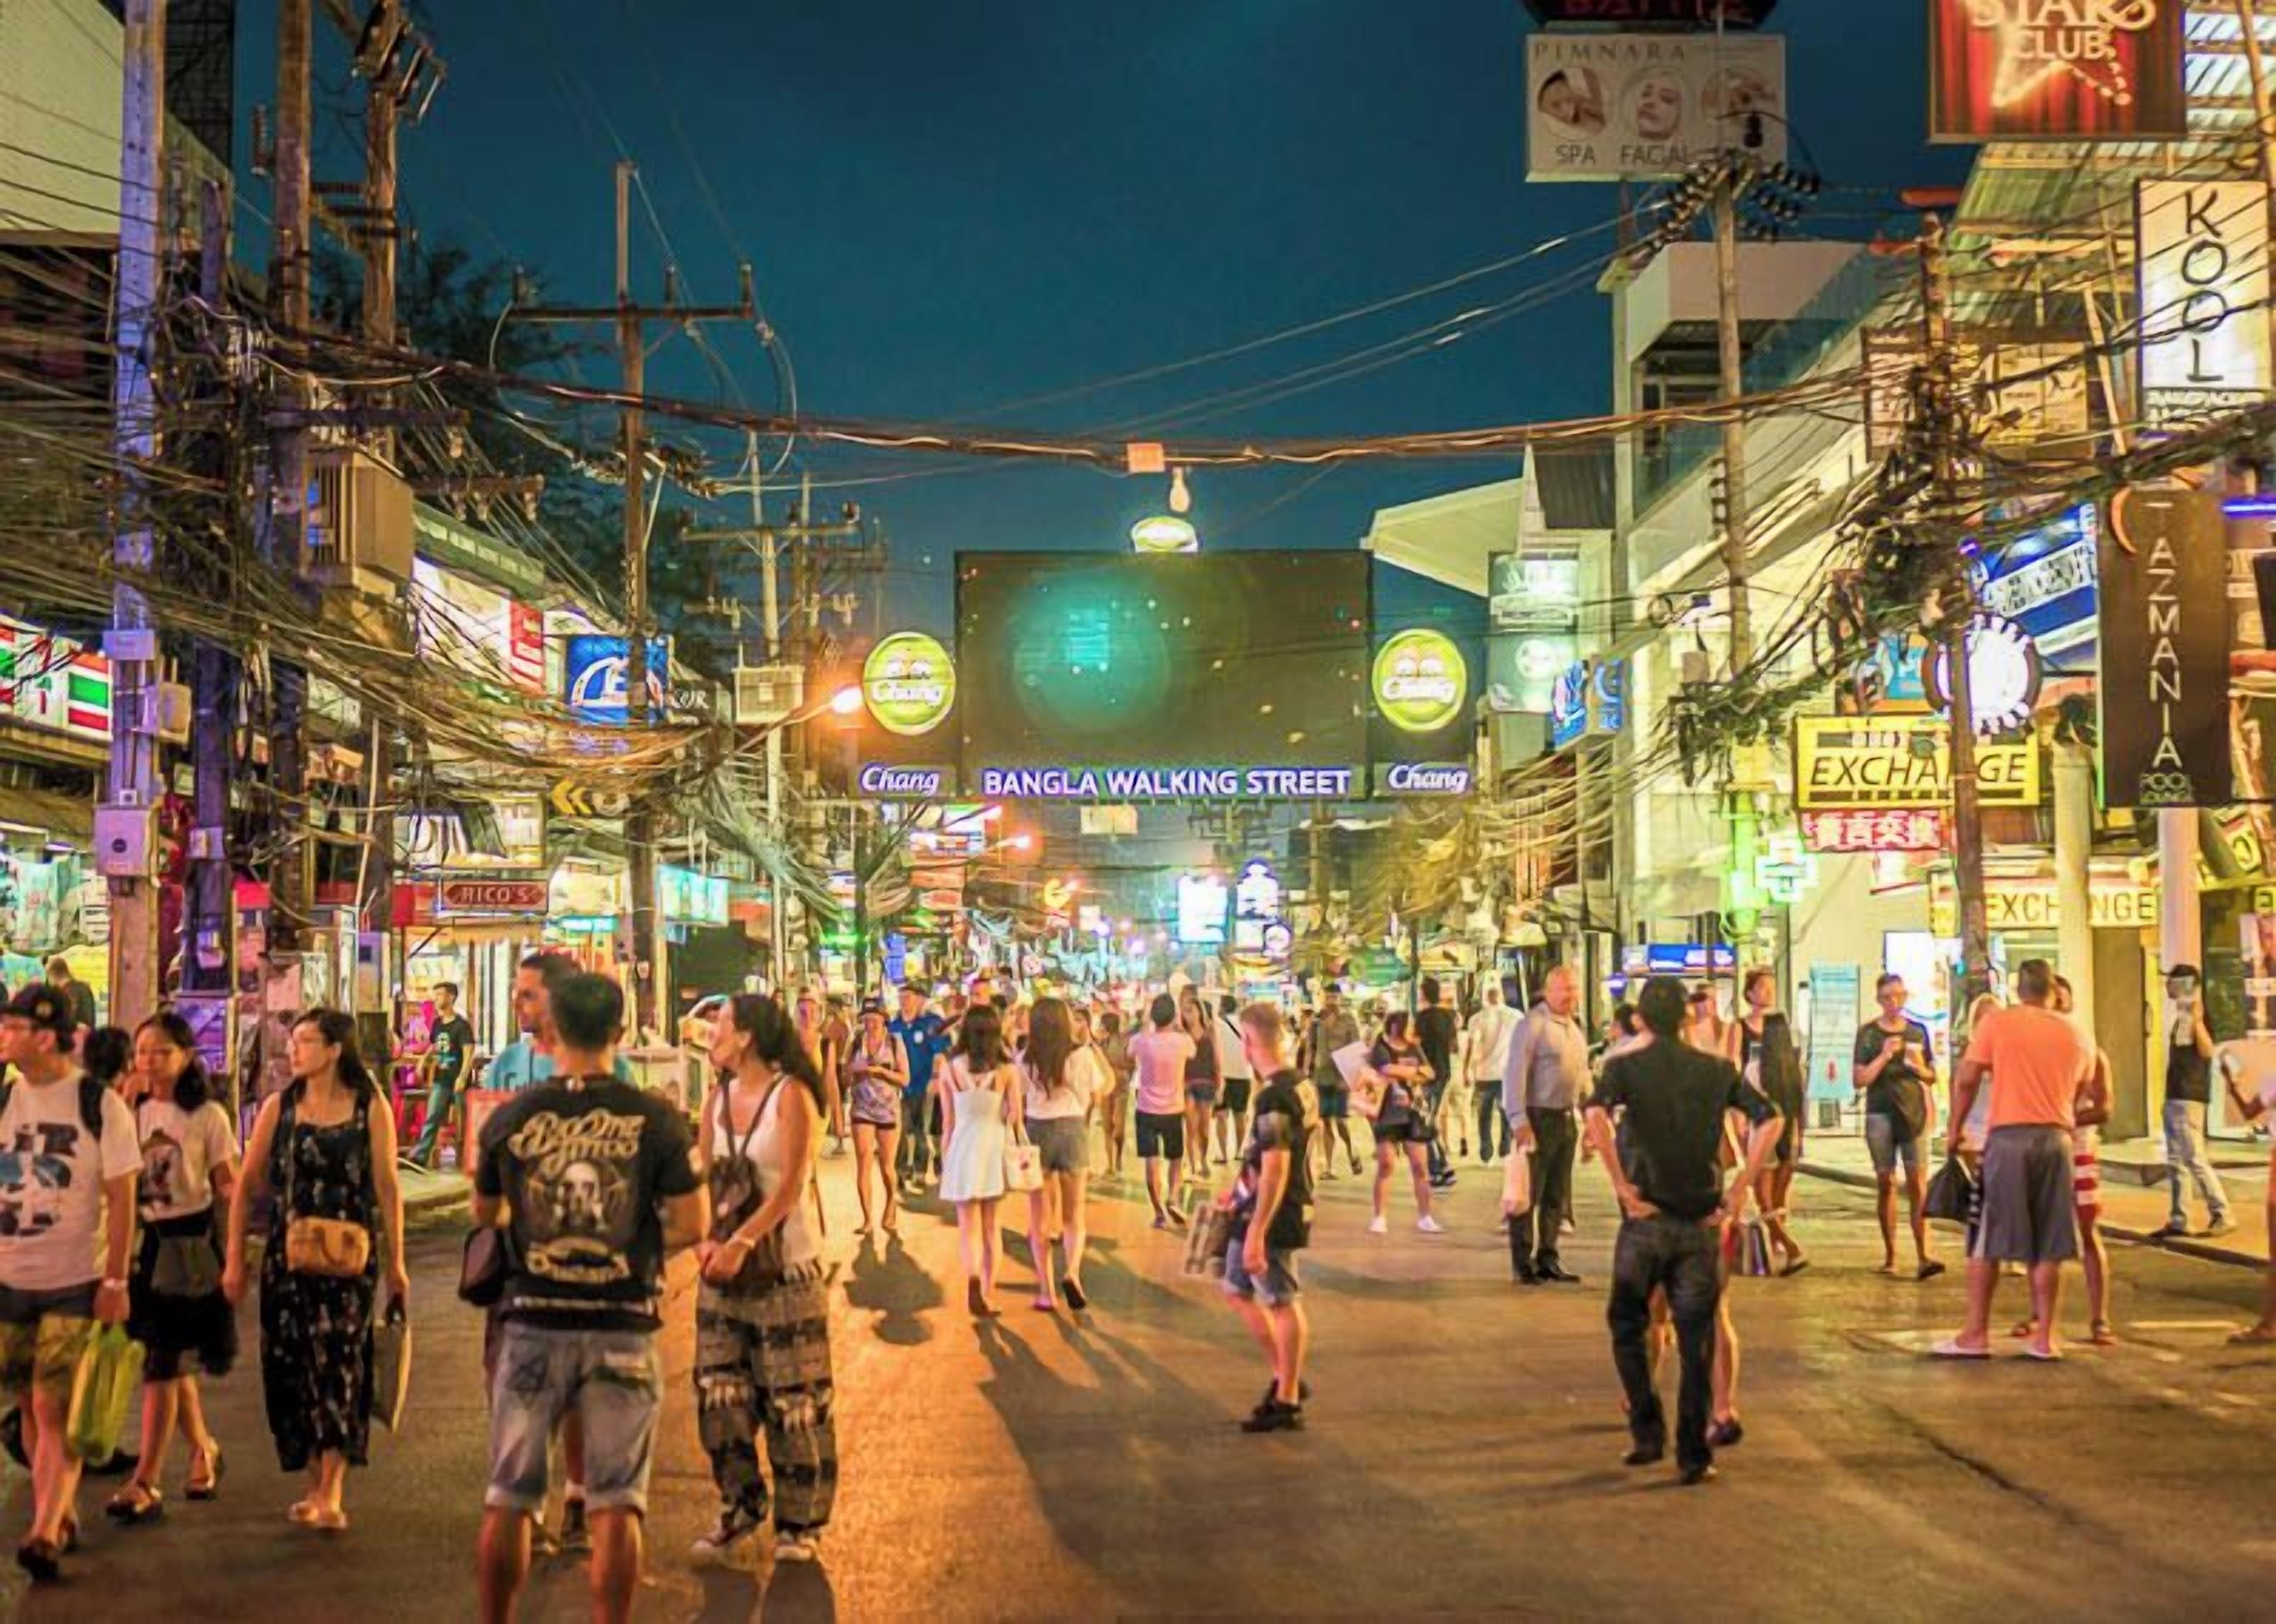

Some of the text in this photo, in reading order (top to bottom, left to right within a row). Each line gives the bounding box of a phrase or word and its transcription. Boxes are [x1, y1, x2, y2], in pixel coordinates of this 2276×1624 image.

[1535, 43, 1686, 62] PIMNARA
[2014, 29, 2107, 60] CLUB
[1555, 146, 1597, 166] SPA
[2181, 189, 2228, 383] KOOL
[2144, 502, 2183, 768] TAZMANIA
[861, 766, 940, 795] Chang
[983, 769, 1351, 796] BANGLA WALKING STREET
[1388, 764, 1469, 794] Chang
[1809, 752, 2028, 786] EXCHAGE
